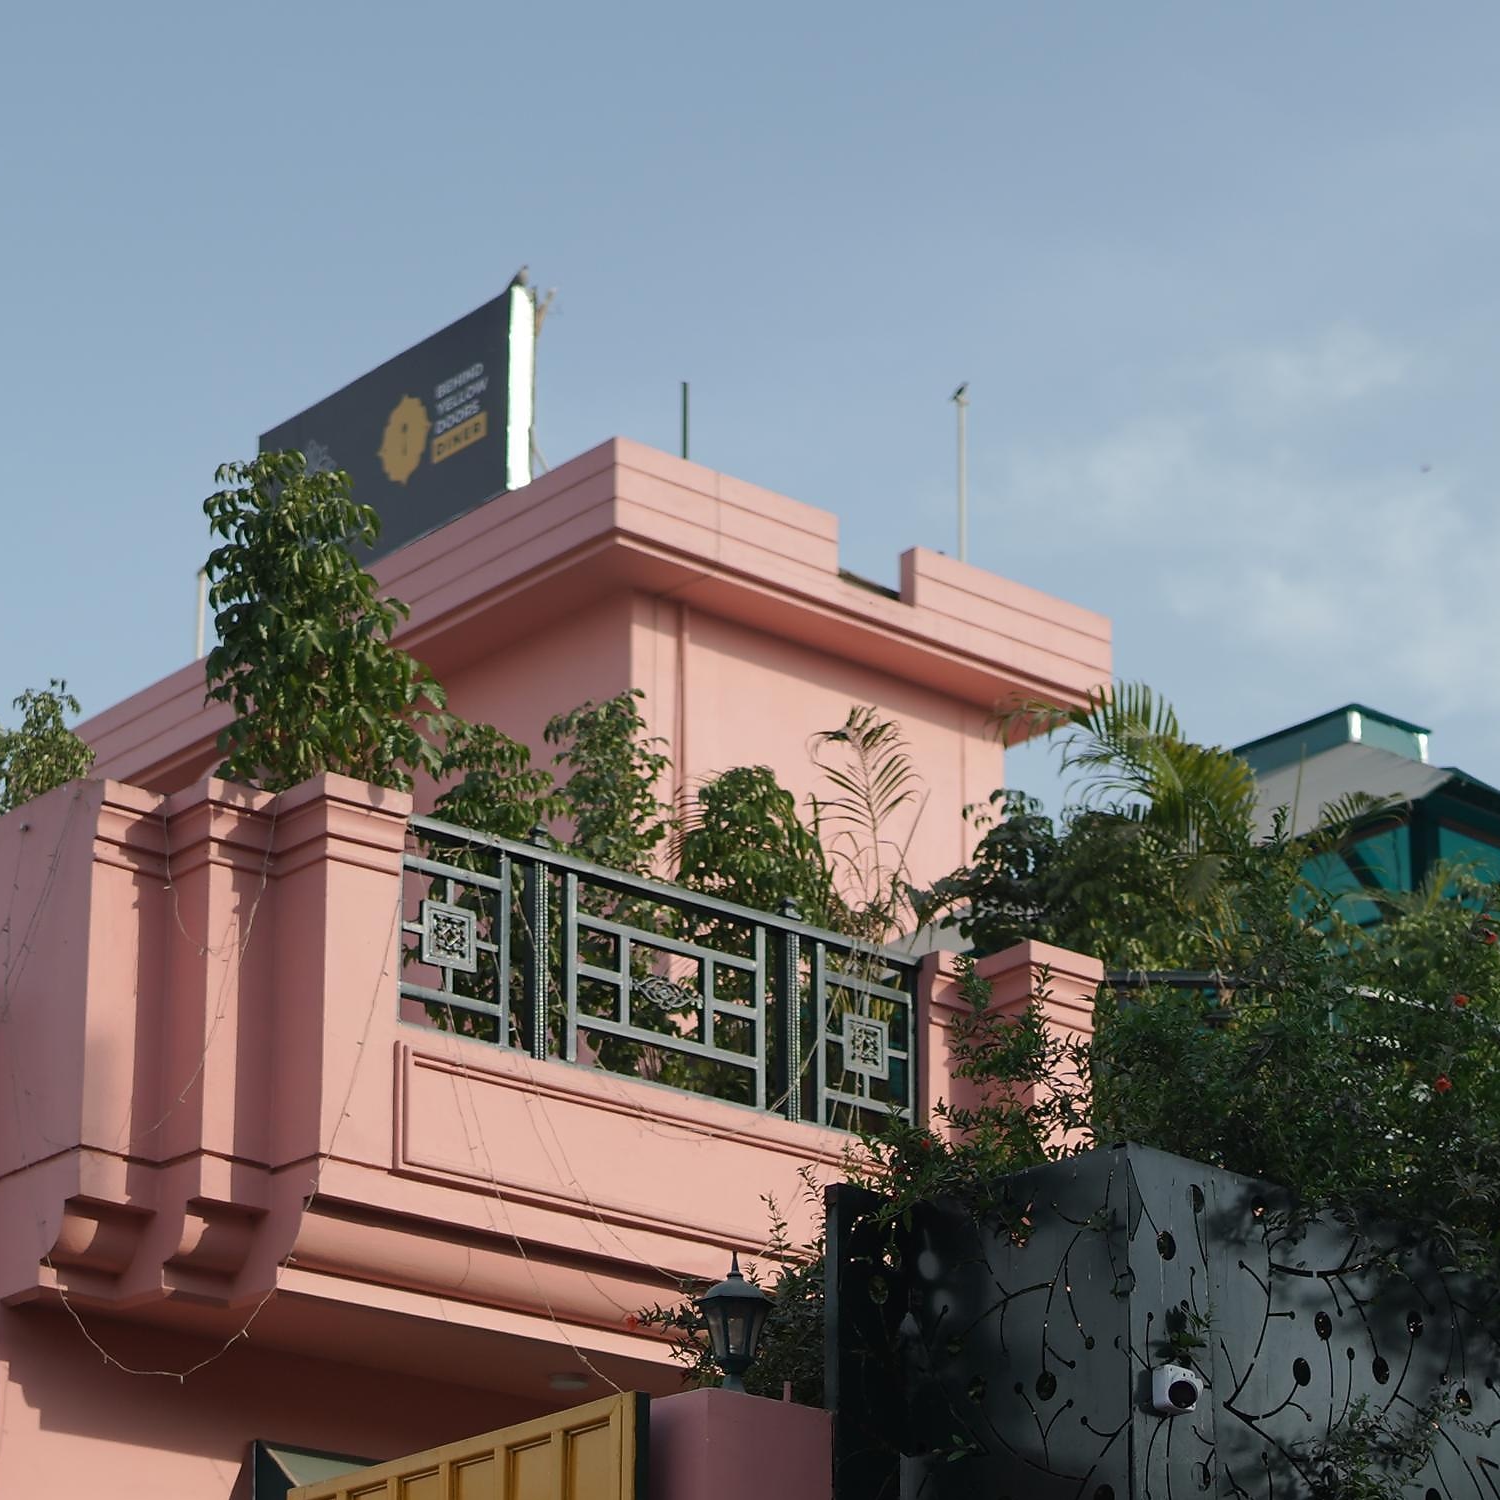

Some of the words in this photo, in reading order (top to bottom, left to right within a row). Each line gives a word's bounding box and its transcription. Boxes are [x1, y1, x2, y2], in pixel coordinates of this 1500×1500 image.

[434, 362, 485, 400] BEHIND
[435, 376, 490, 416] YELLOW
[434, 399, 481, 434] DOORS
[437, 422, 481, 456] DINER
